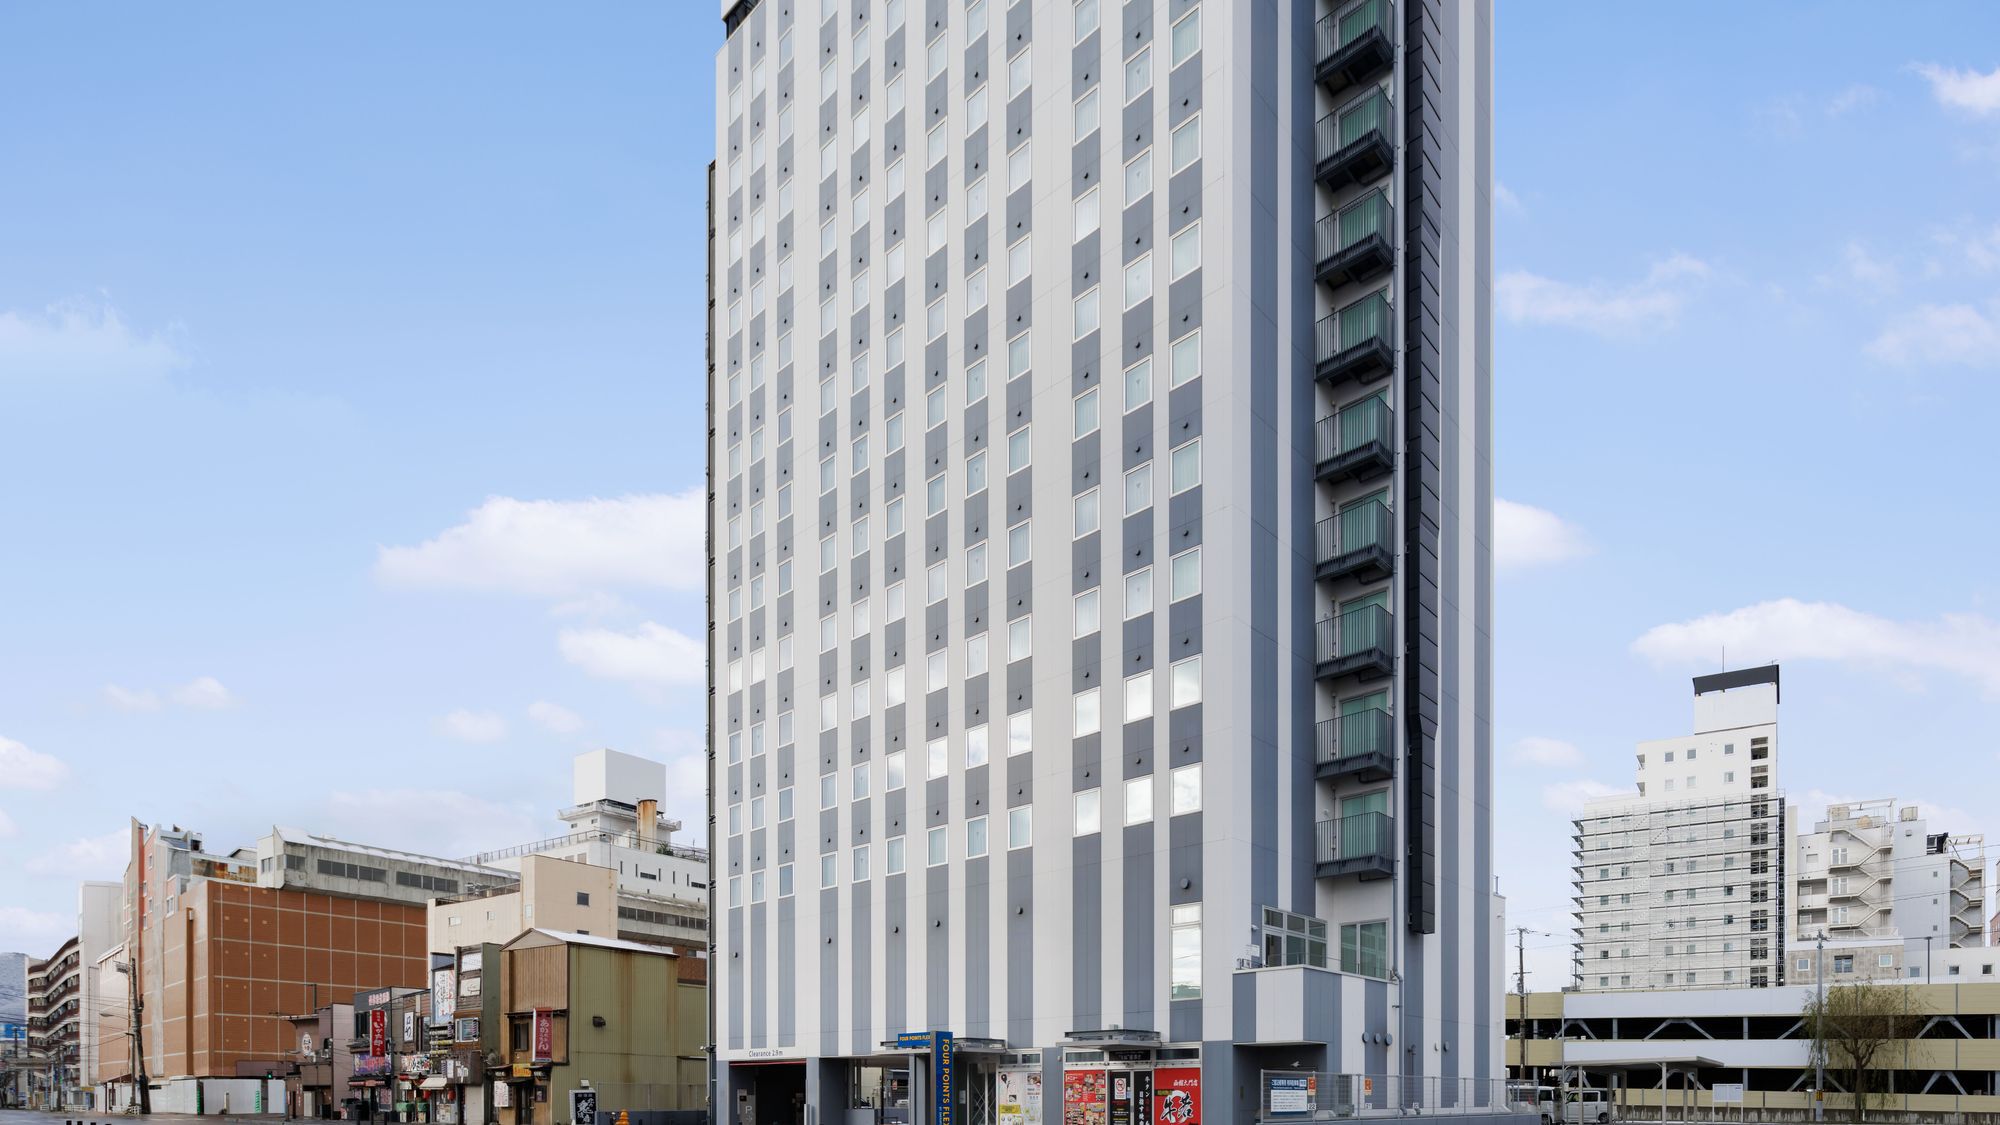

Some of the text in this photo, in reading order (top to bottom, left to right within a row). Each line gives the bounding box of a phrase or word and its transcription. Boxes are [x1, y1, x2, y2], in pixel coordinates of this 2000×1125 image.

[942, 1038, 950, 1065] FOUR
[942, 1069, 950, 1104] POINTS
[745, 1106, 752, 1114] P
[1160, 1091, 1194, 1121] 牛若
